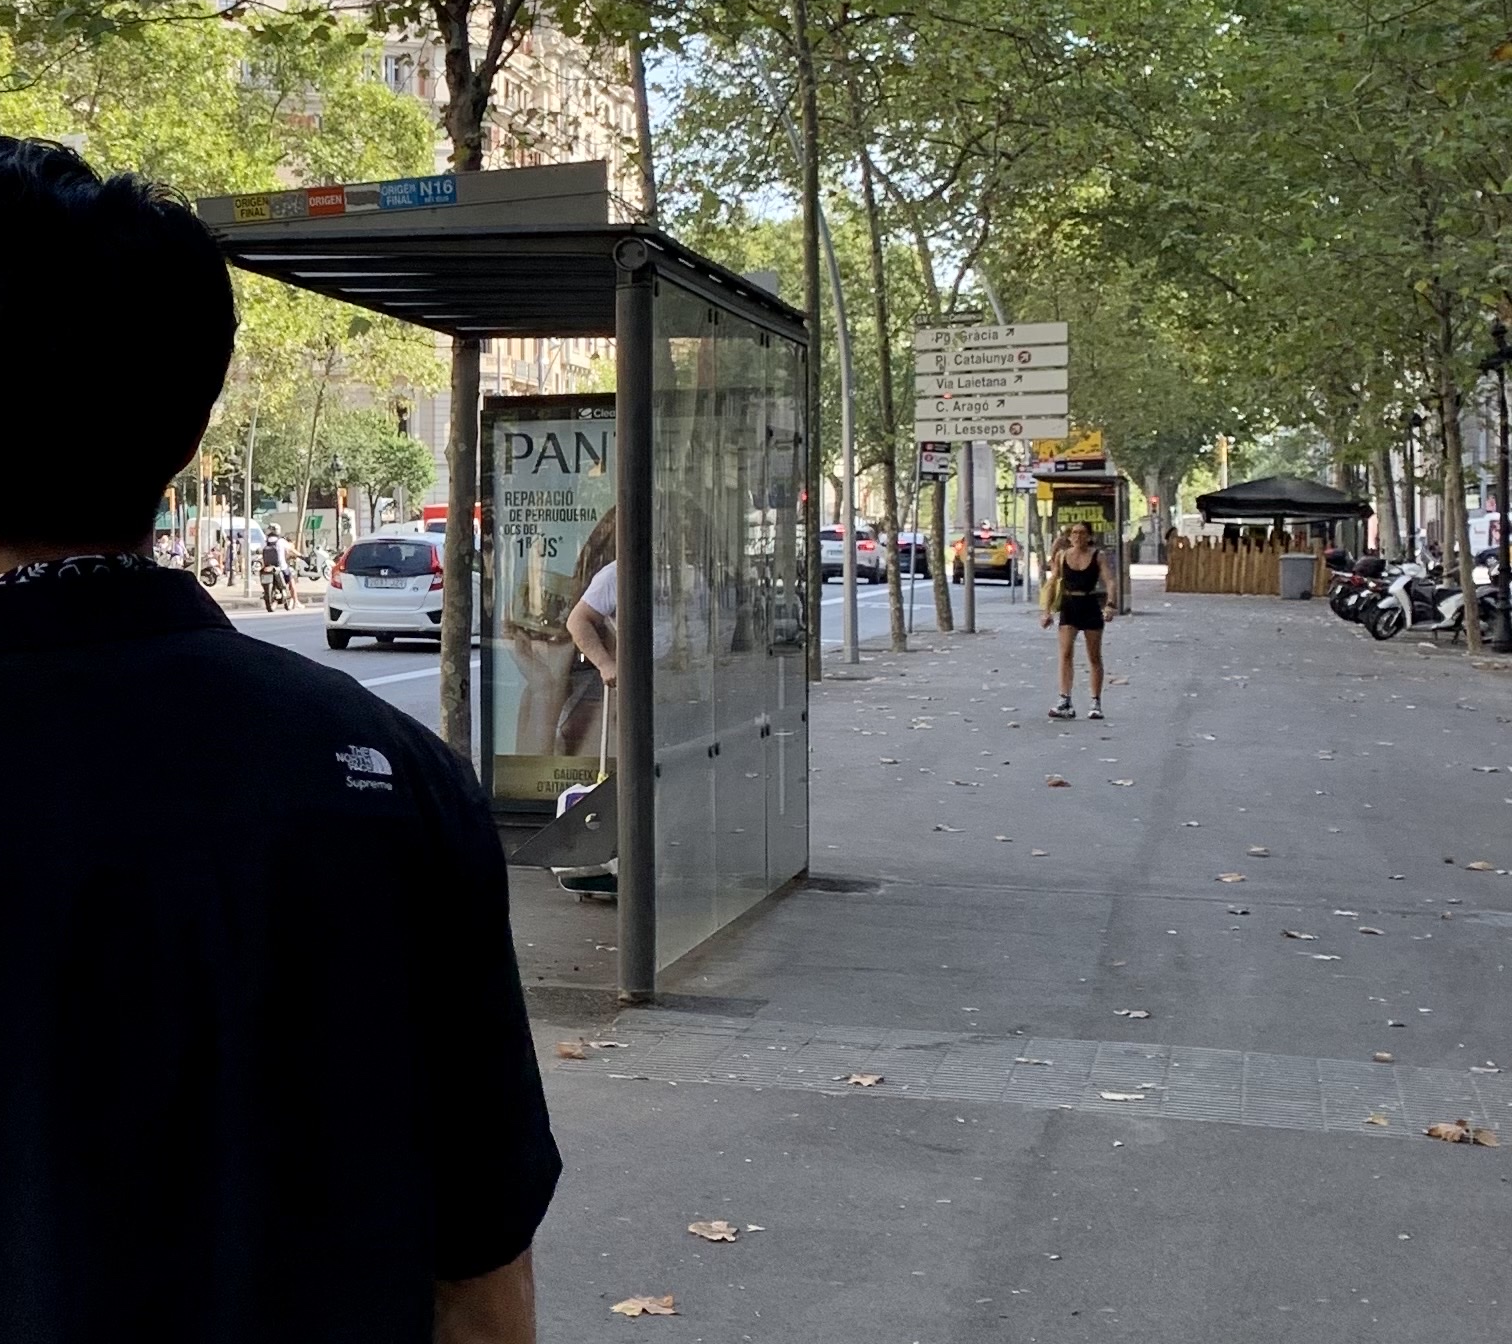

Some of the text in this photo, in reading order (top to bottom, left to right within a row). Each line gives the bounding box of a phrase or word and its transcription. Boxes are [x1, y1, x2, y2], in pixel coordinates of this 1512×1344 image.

[420, 179, 453, 196] N16
[235, 195, 269, 208] ORIGEN
[309, 195, 342, 207] ORIGEN
[386, 192, 413, 205] FINAL
[240, 206, 266, 218] FINAL
[954, 353, 1015, 366] Catalunya
[936, 377, 1007, 390] Via Laietana
[935, 400, 989, 414] C. Aragó
[935, 423, 1006, 436] Pl. Lesseps
[504, 431, 616, 475] PAN
[504, 488, 574, 507] REPARACIÓ
[509, 508, 598, 522] DE PERRUQUERIA
